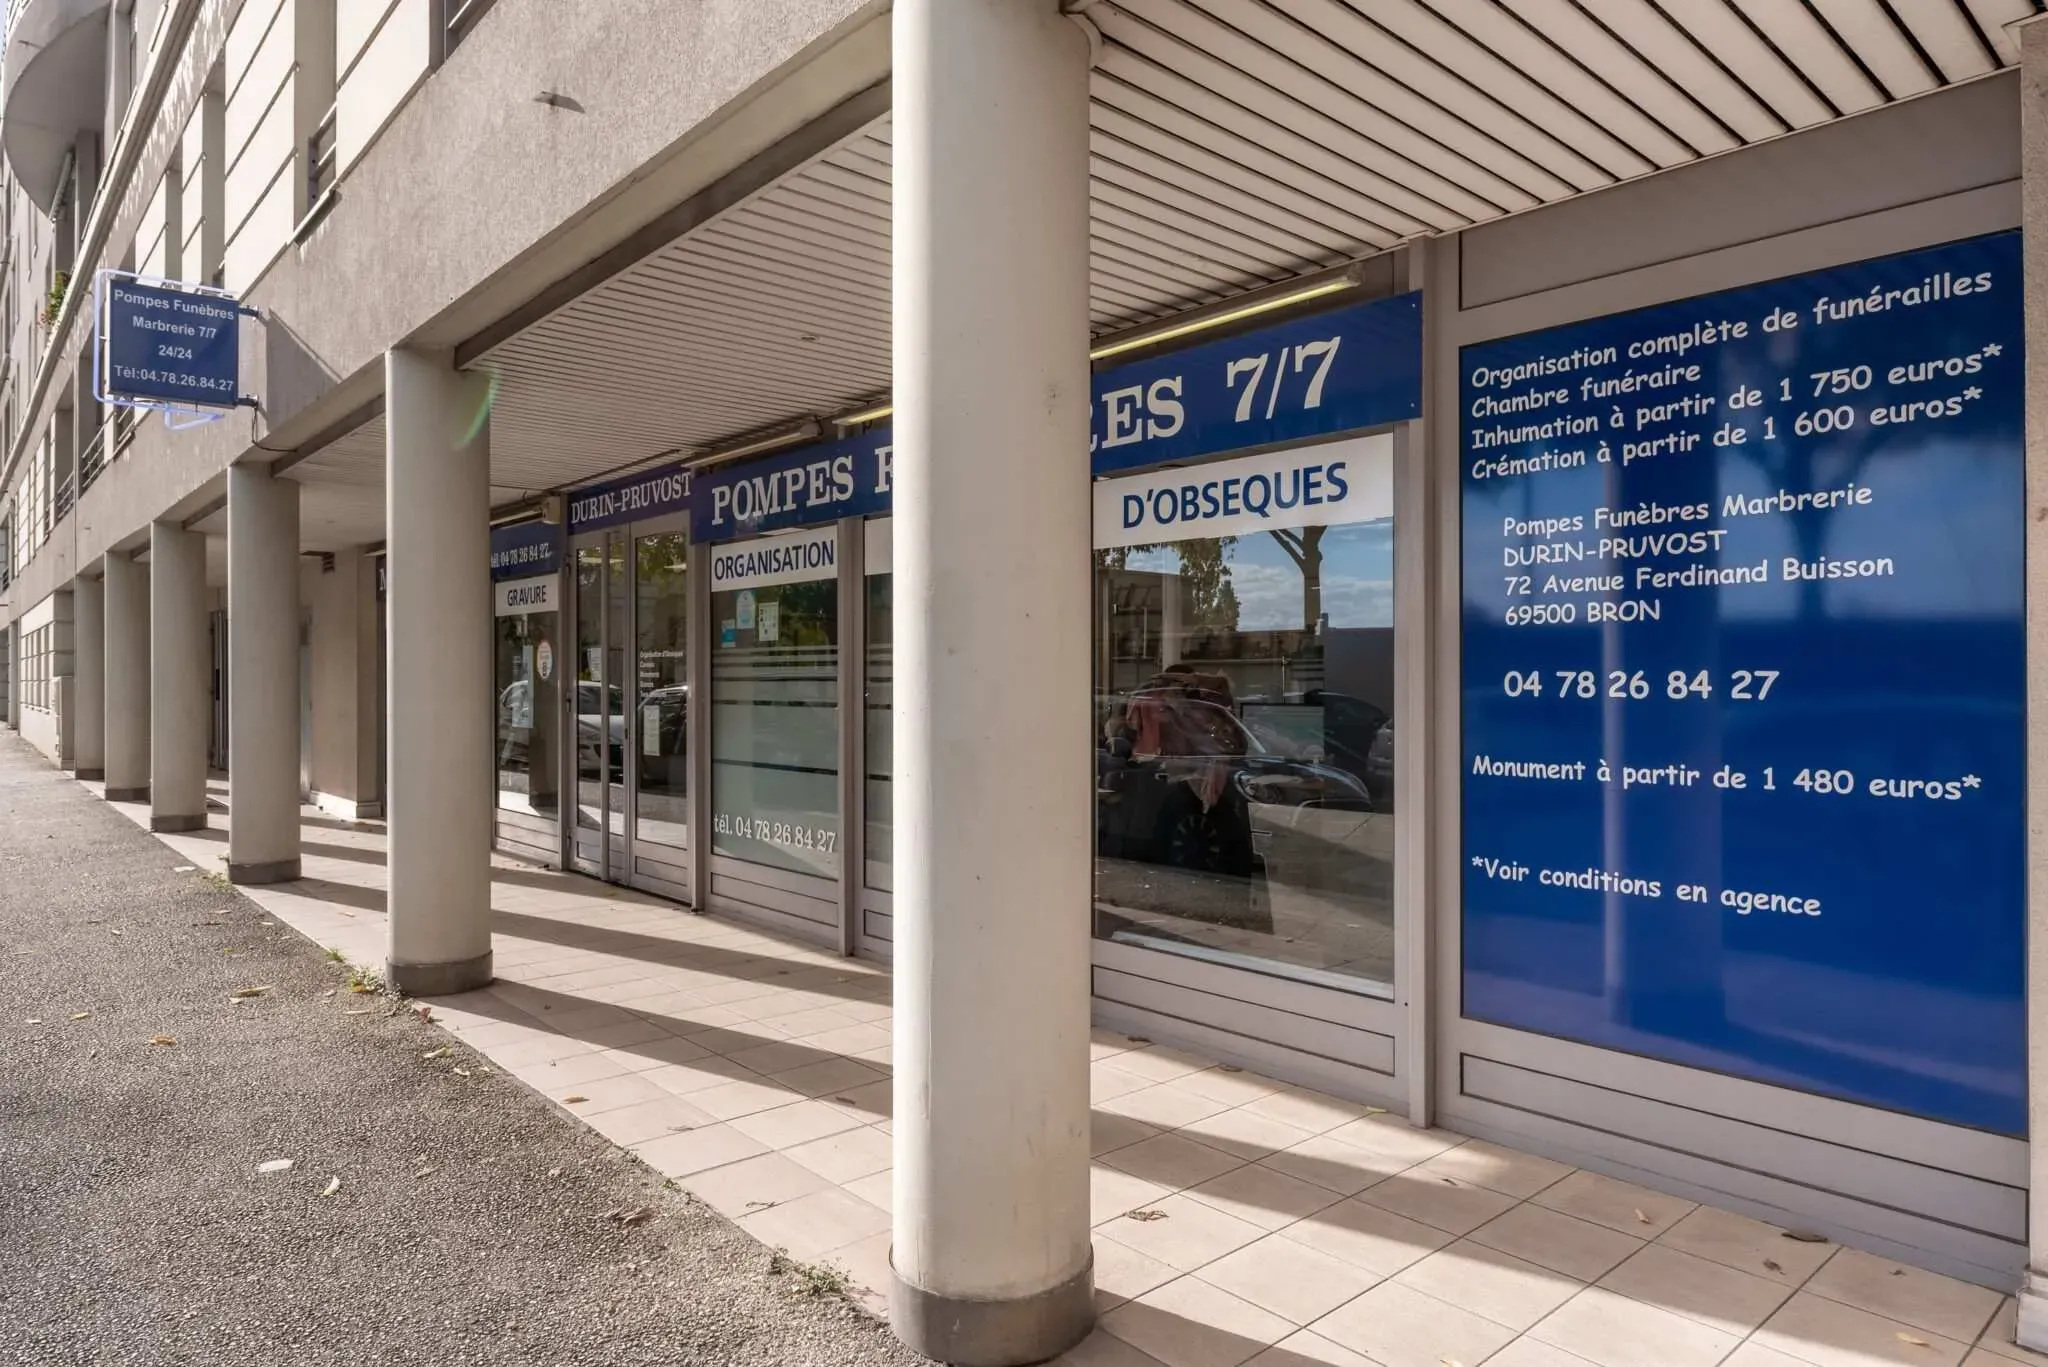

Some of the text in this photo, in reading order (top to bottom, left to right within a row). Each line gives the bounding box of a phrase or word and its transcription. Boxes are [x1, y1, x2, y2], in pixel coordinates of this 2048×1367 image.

[114, 289, 234, 320] Pompes Funèbres
[132, 315, 217, 340] Marbrerie 7/7
[1472, 272, 1991, 390] Organisation complète de funérailles
[158, 345, 192, 360] 24/24
[1472, 363, 1700, 418] Chambre funéraire
[1472, 416, 1598, 449] Inhumation
[1610, 405, 1625, 428] à
[1637, 397, 1715, 435] partir
[1728, 384, 1762, 409] de
[1780, 378, 1792, 401] 1
[1810, 365, 1872, 397] 750
[712, 455, 854, 526] POMPES
[1226, 336, 1341, 423] 7/7
[1472, 446, 1586, 480] Crémation
[1596, 440, 1611, 463] à
[1623, 430, 1700, 466] partir
[1713, 422, 1747, 447] de
[1764, 417, 1776, 440] 1
[1794, 406, 1855, 436] 600
[571, 472, 691, 524] DURIN-PRUVOST
[1123, 462, 1348, 529] D'OBSEQUES
[1503, 483, 1873, 540] Pompes Funèbres Marbrerie
[715, 539, 834, 580] ORGANISATION
[1503, 529, 1728, 569] DURIN-PRUVOST
[507, 585, 546, 607] GRAVURE
[1504, 556, 1894, 596] 72 Avenue Ferdinand Buisson
[1505, 599, 1660, 626] 69500 BRON
[1504, 670, 1780, 700] 04 78 26 84 27
[1473, 755, 1586, 780] Monument
[1597, 759, 1612, 782] à
[1623, 764, 1700, 790] partir
[1712, 765, 1746, 789] de
[1763, 767, 1776, 790] 1
[1793, 768, 1854, 794] 480
[714, 813, 836, 852] tél. 04 78 26 84 27
[1539, 868, 1661, 897] conditions
[1676, 884, 1708, 903] en
[1720, 890, 1821, 916] agence
